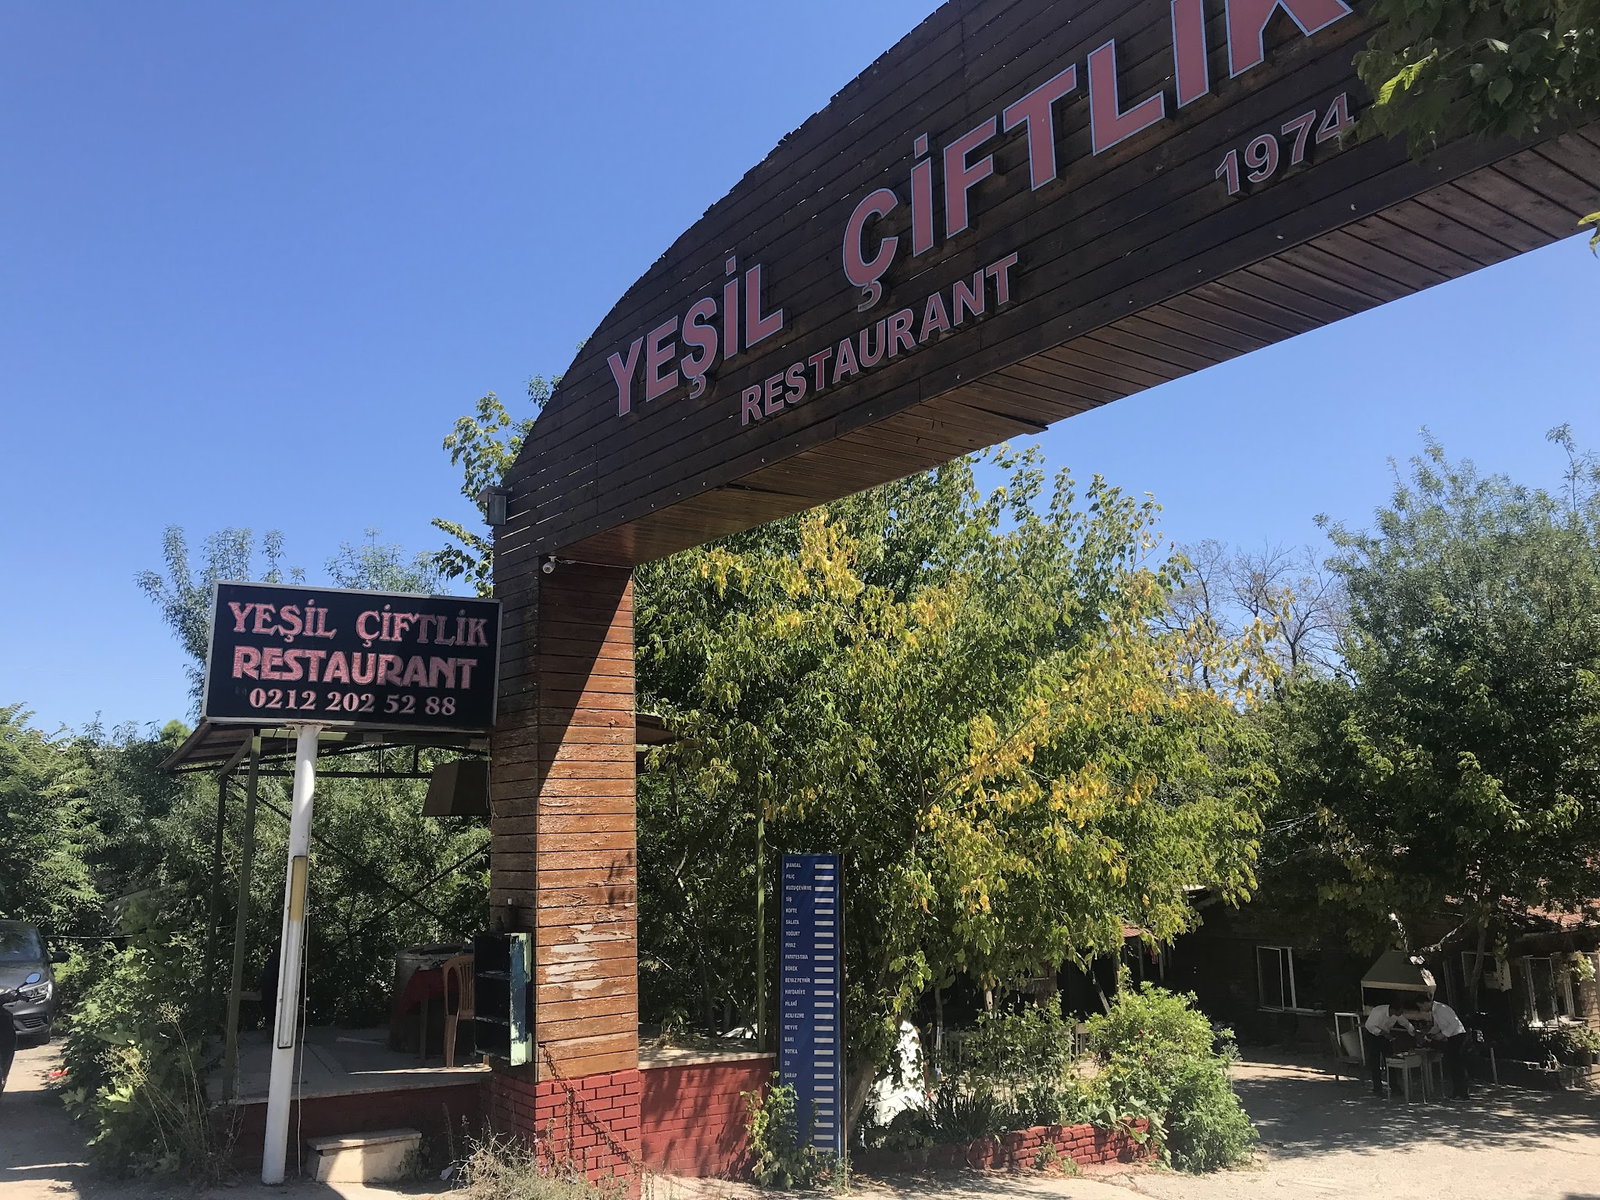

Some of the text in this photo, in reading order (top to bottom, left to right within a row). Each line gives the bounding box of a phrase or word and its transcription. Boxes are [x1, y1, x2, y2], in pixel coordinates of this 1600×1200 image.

[1215, 92, 1354, 195] 1974
[606, 255, 784, 417] YEŞİL
[741, 252, 1018, 426] RESTAURANT
[228, 599, 489, 648] YEŞİL ÇİFTLİK
[232, 645, 478, 689] RESTAURANT
[249, 688, 457, 716] 0212 202 52 88
